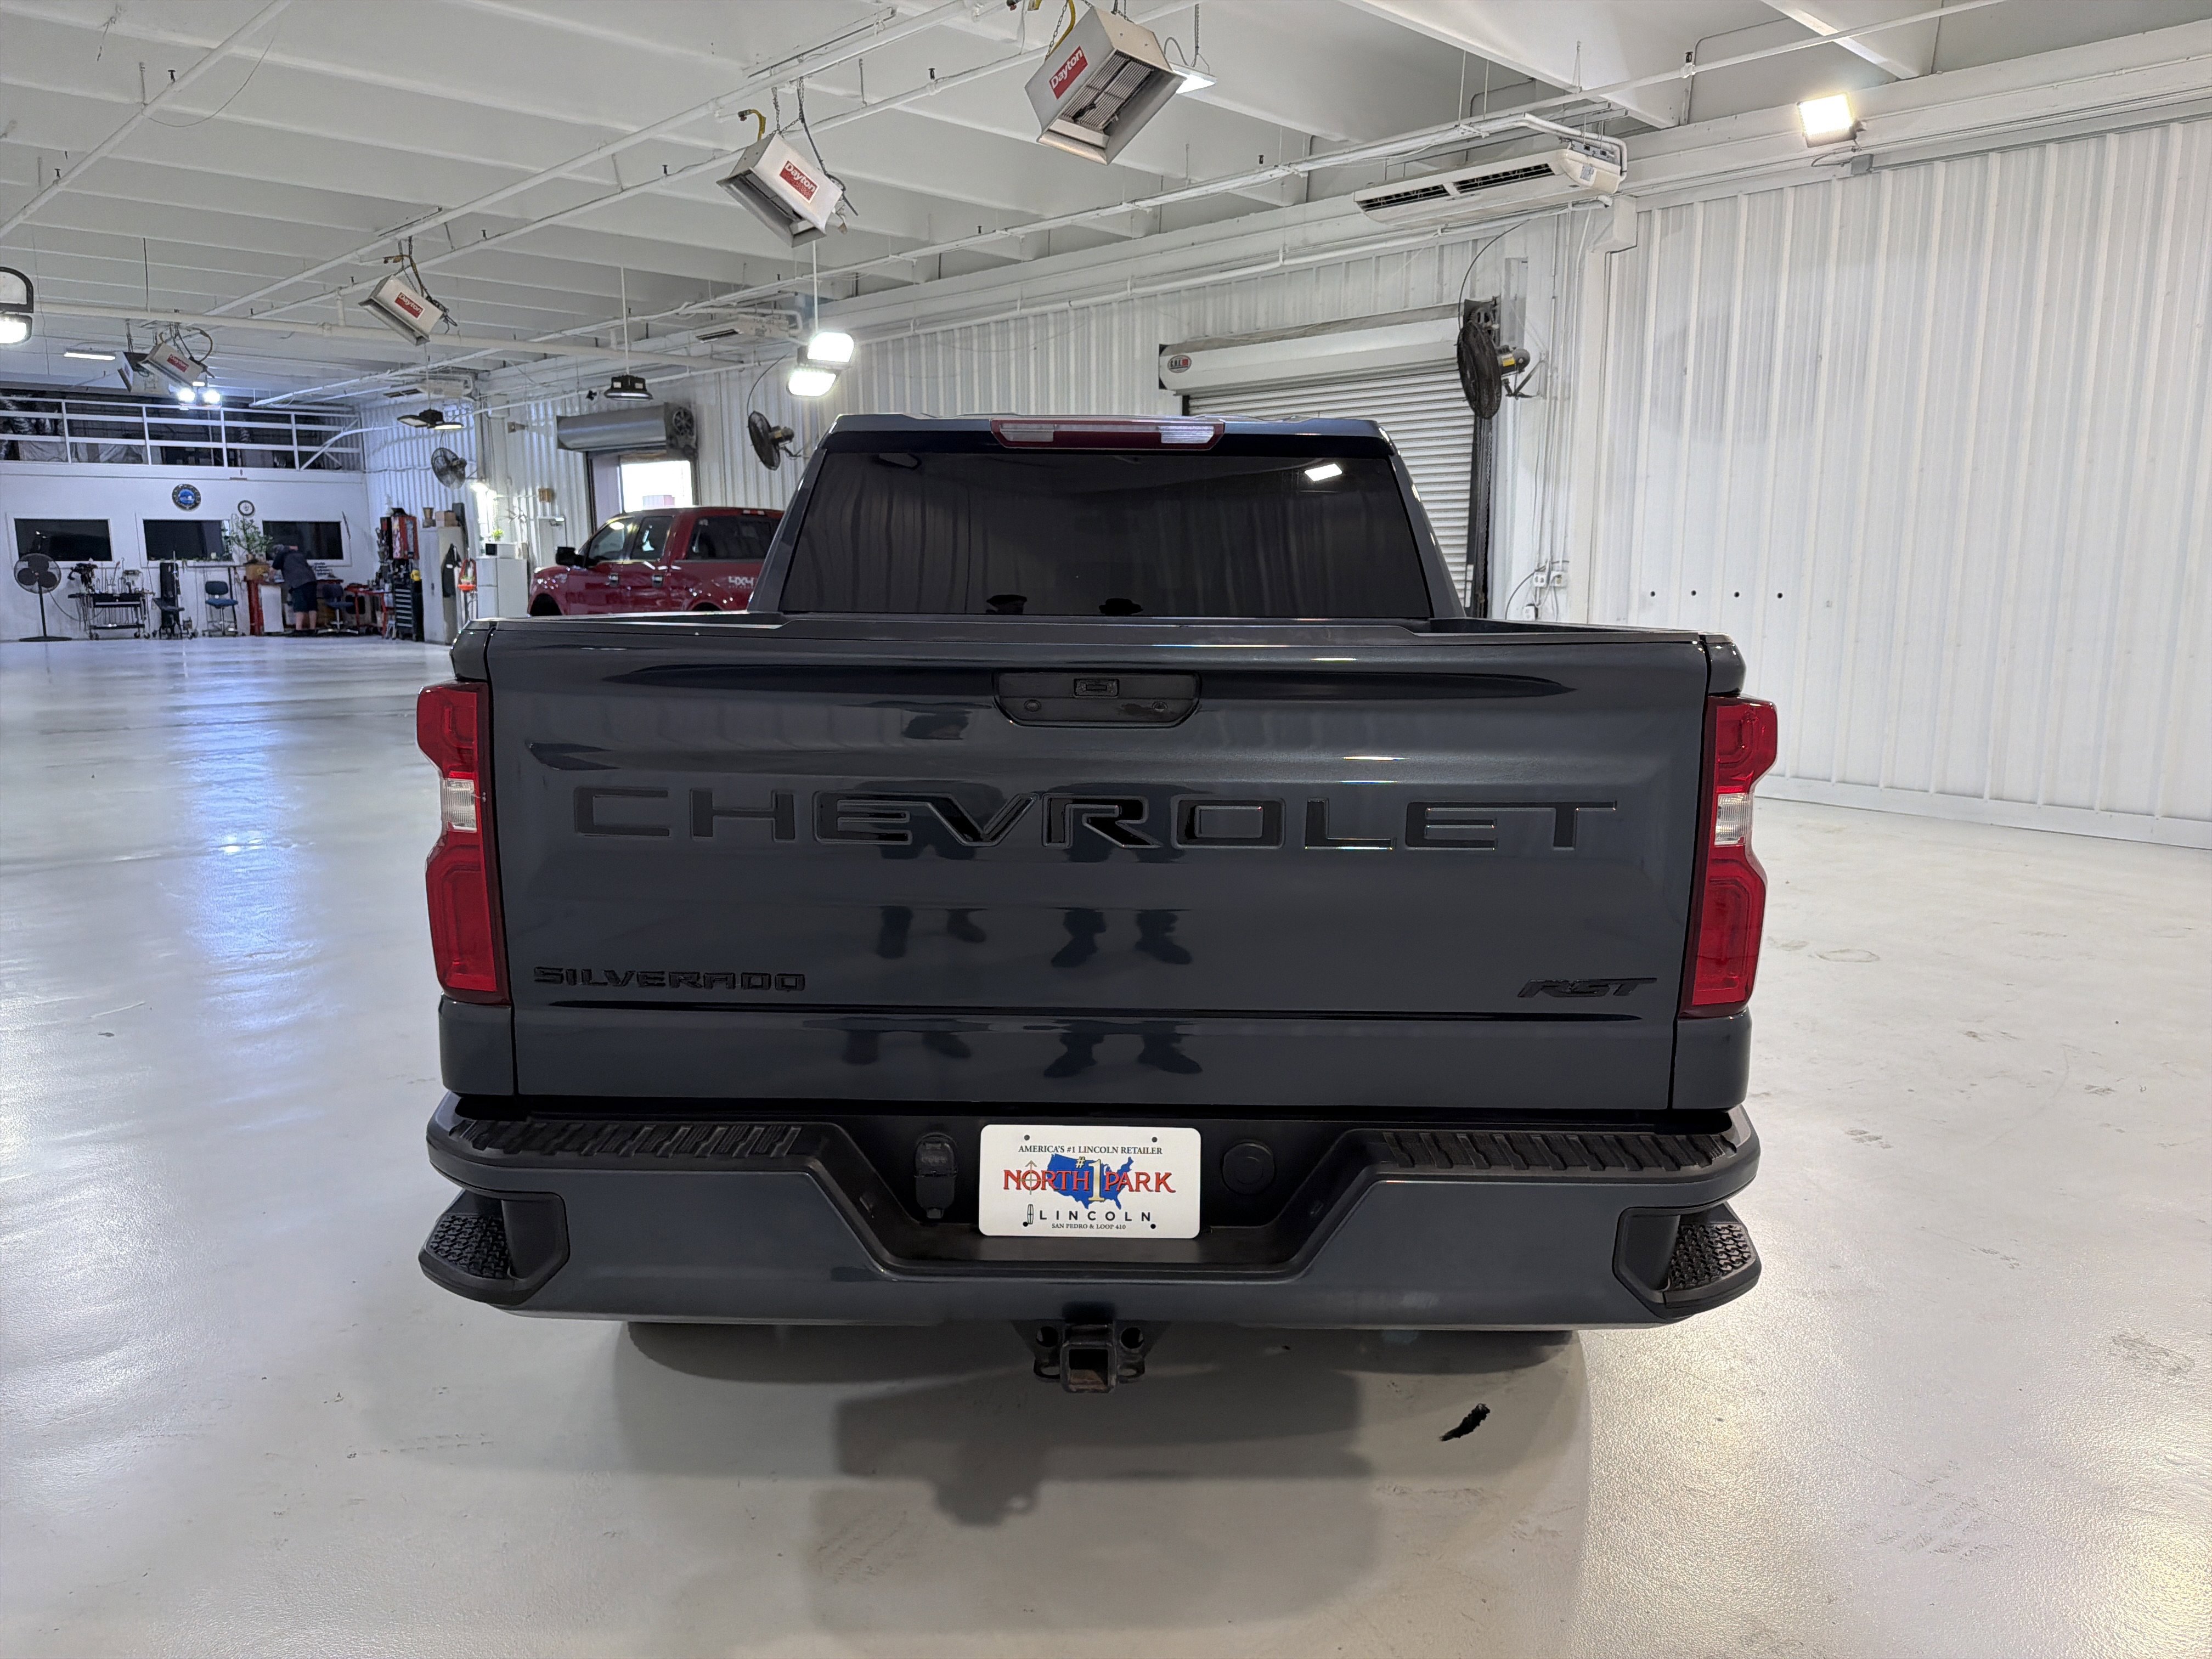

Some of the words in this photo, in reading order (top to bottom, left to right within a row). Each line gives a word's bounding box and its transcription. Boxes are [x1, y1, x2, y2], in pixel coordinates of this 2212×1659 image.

[1051, 49, 1083, 89] Dayton
[785, 162, 816, 192] Dayton
[398, 294, 422, 313] Dayton
[573, 786, 1618, 851] CHEVROLET
[533, 966, 805, 991] SILVERADO
[1517, 977, 1657, 997] RST
[1078, 1146, 1119, 1154] LINCOLN
[1120, 1147, 1163, 1155] RETAILER
[1003, 1169, 1090, 1191] NORTH
[1104, 1171, 1177, 1193] PARK
[1039, 1210, 1151, 1222] LINCOLN
